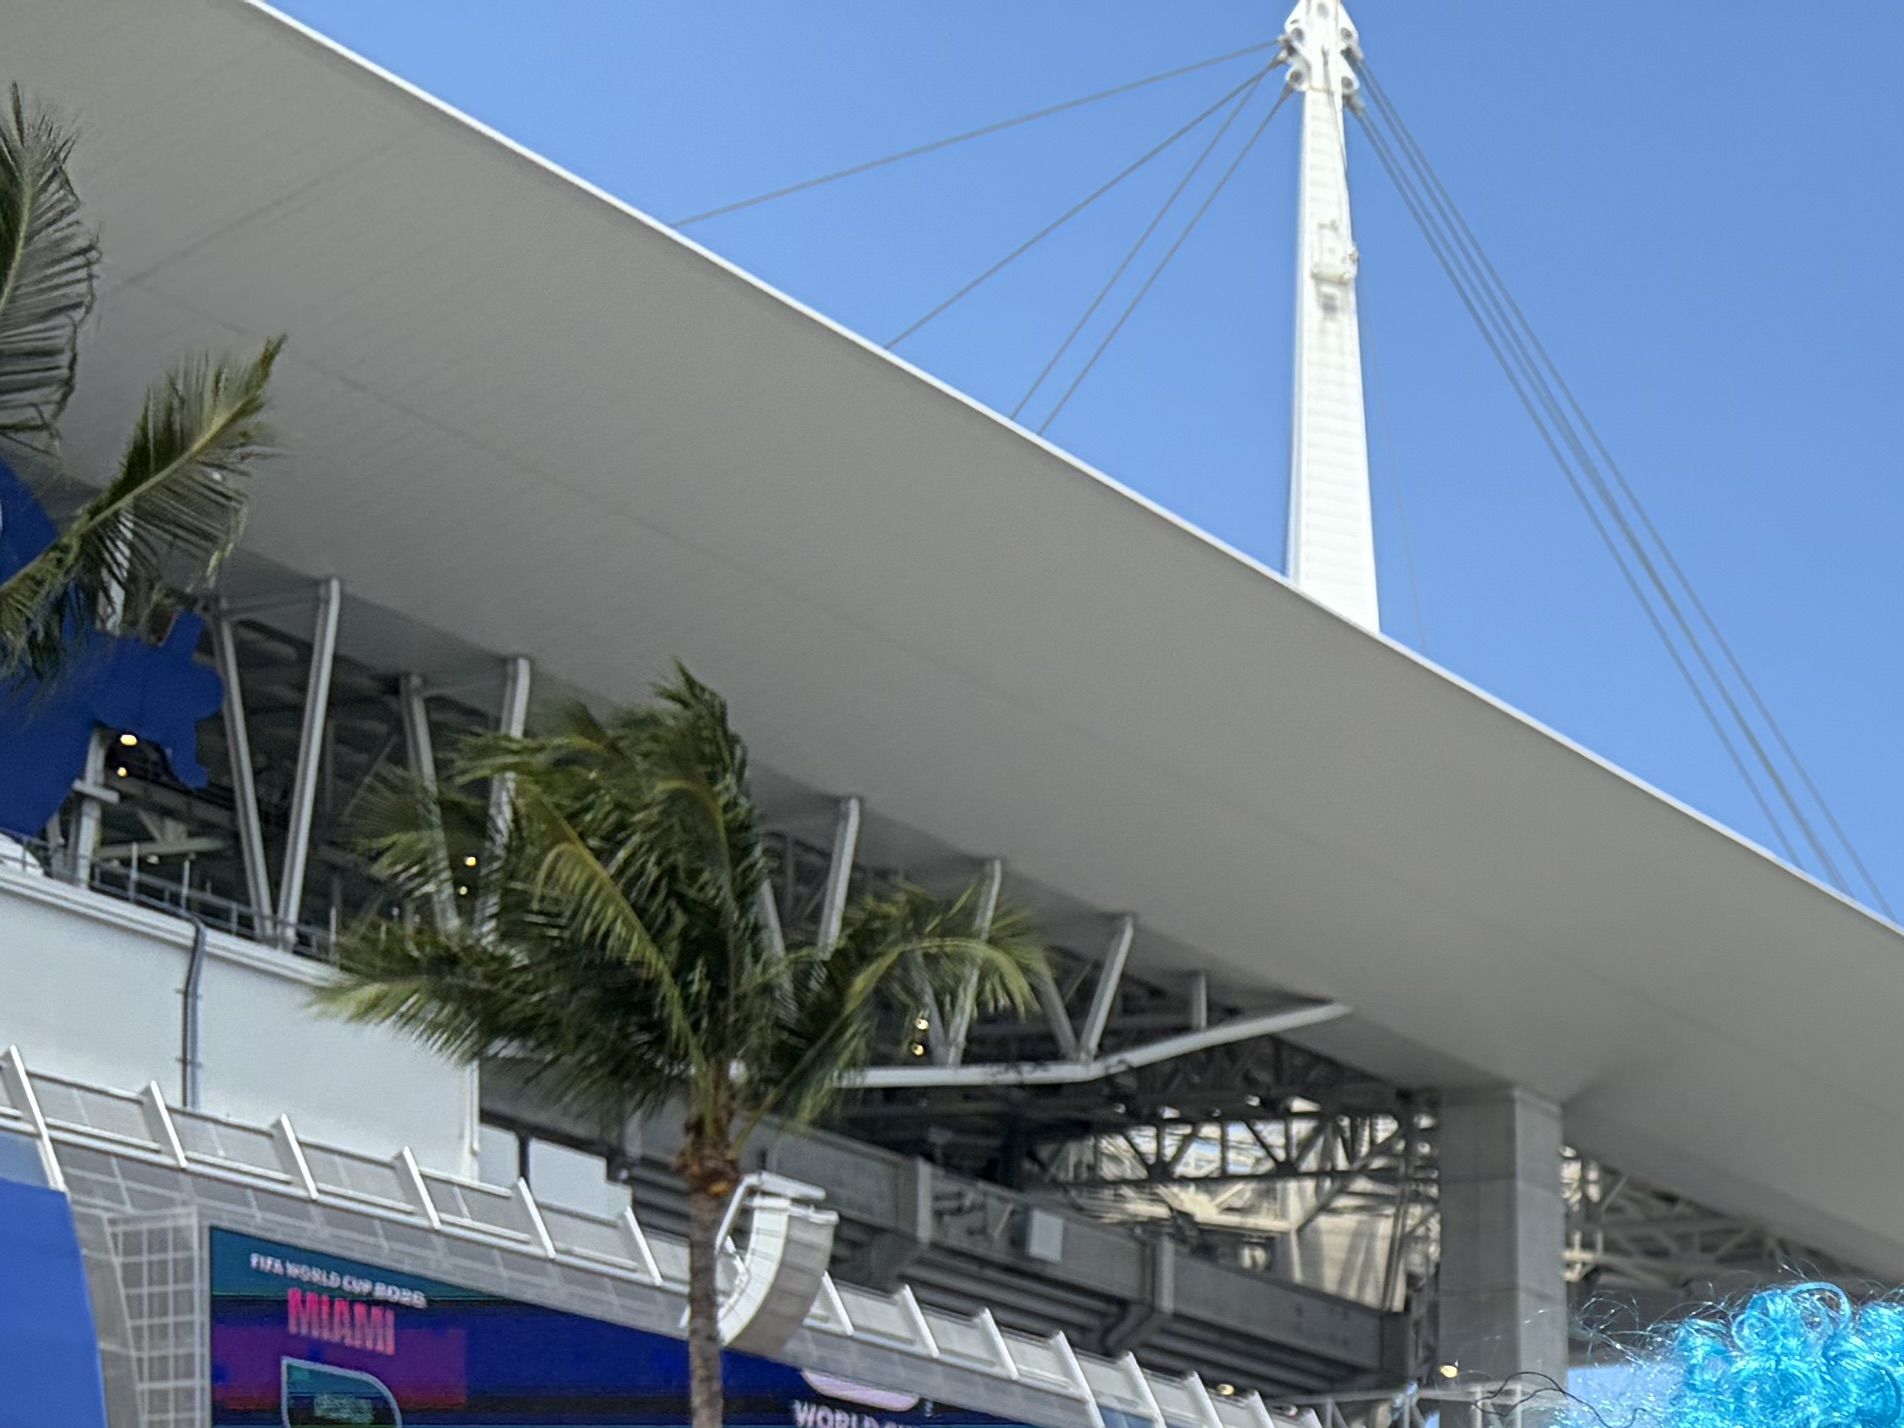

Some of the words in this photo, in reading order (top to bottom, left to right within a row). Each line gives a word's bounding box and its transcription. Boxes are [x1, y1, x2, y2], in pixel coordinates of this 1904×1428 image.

[251, 1253, 284, 1276] FIFA
[286, 1260, 341, 1289] WORLD
[342, 1274, 373, 1296] CUP
[287, 1286, 396, 1357] MIAMI
